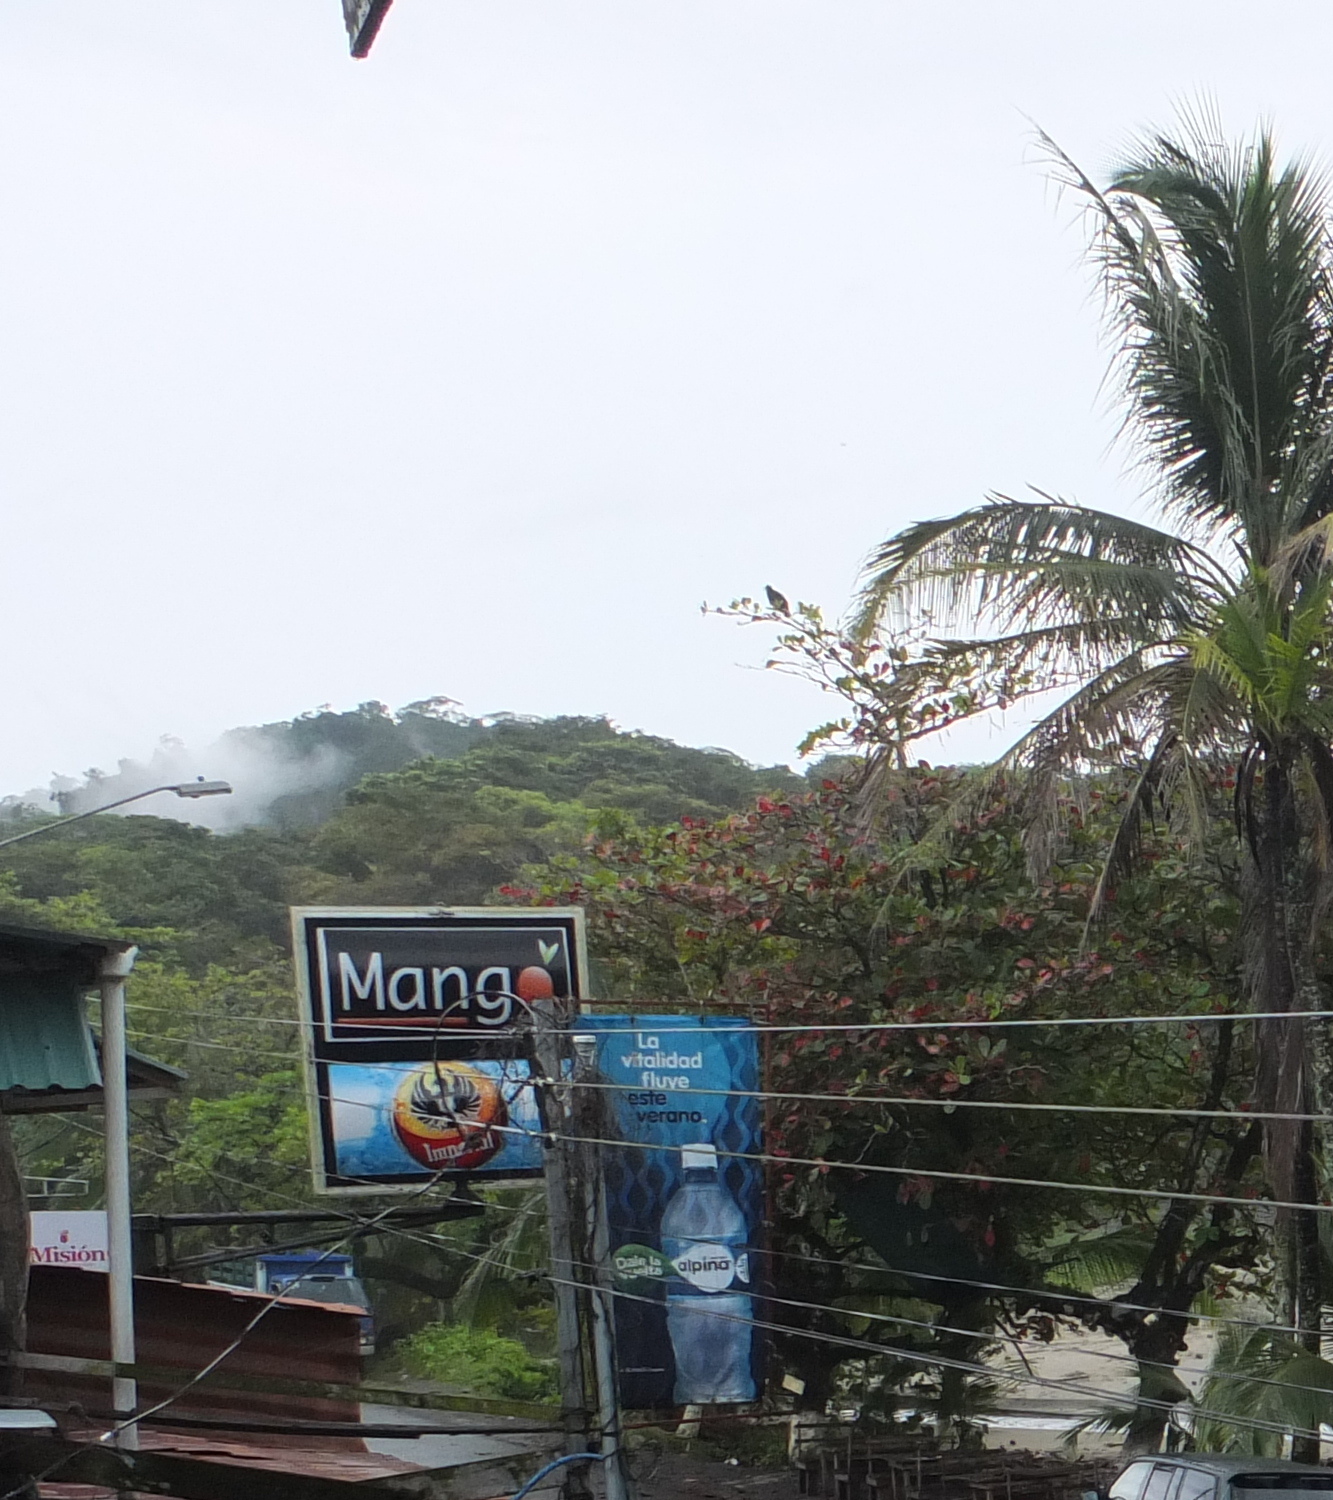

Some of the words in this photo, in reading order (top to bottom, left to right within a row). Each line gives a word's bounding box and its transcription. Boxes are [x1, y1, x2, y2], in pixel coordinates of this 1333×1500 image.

[638, 1033, 659, 1049] La
[621, 1052, 702, 1068] vitalidad
[642, 1071, 689, 1089] fluye
[628, 1091, 667, 1105] este
[423, 1131, 495, 1163] Impal
[29, 1245, 105, 1262] Misión
[678, 1256, 730, 1275] alpina
